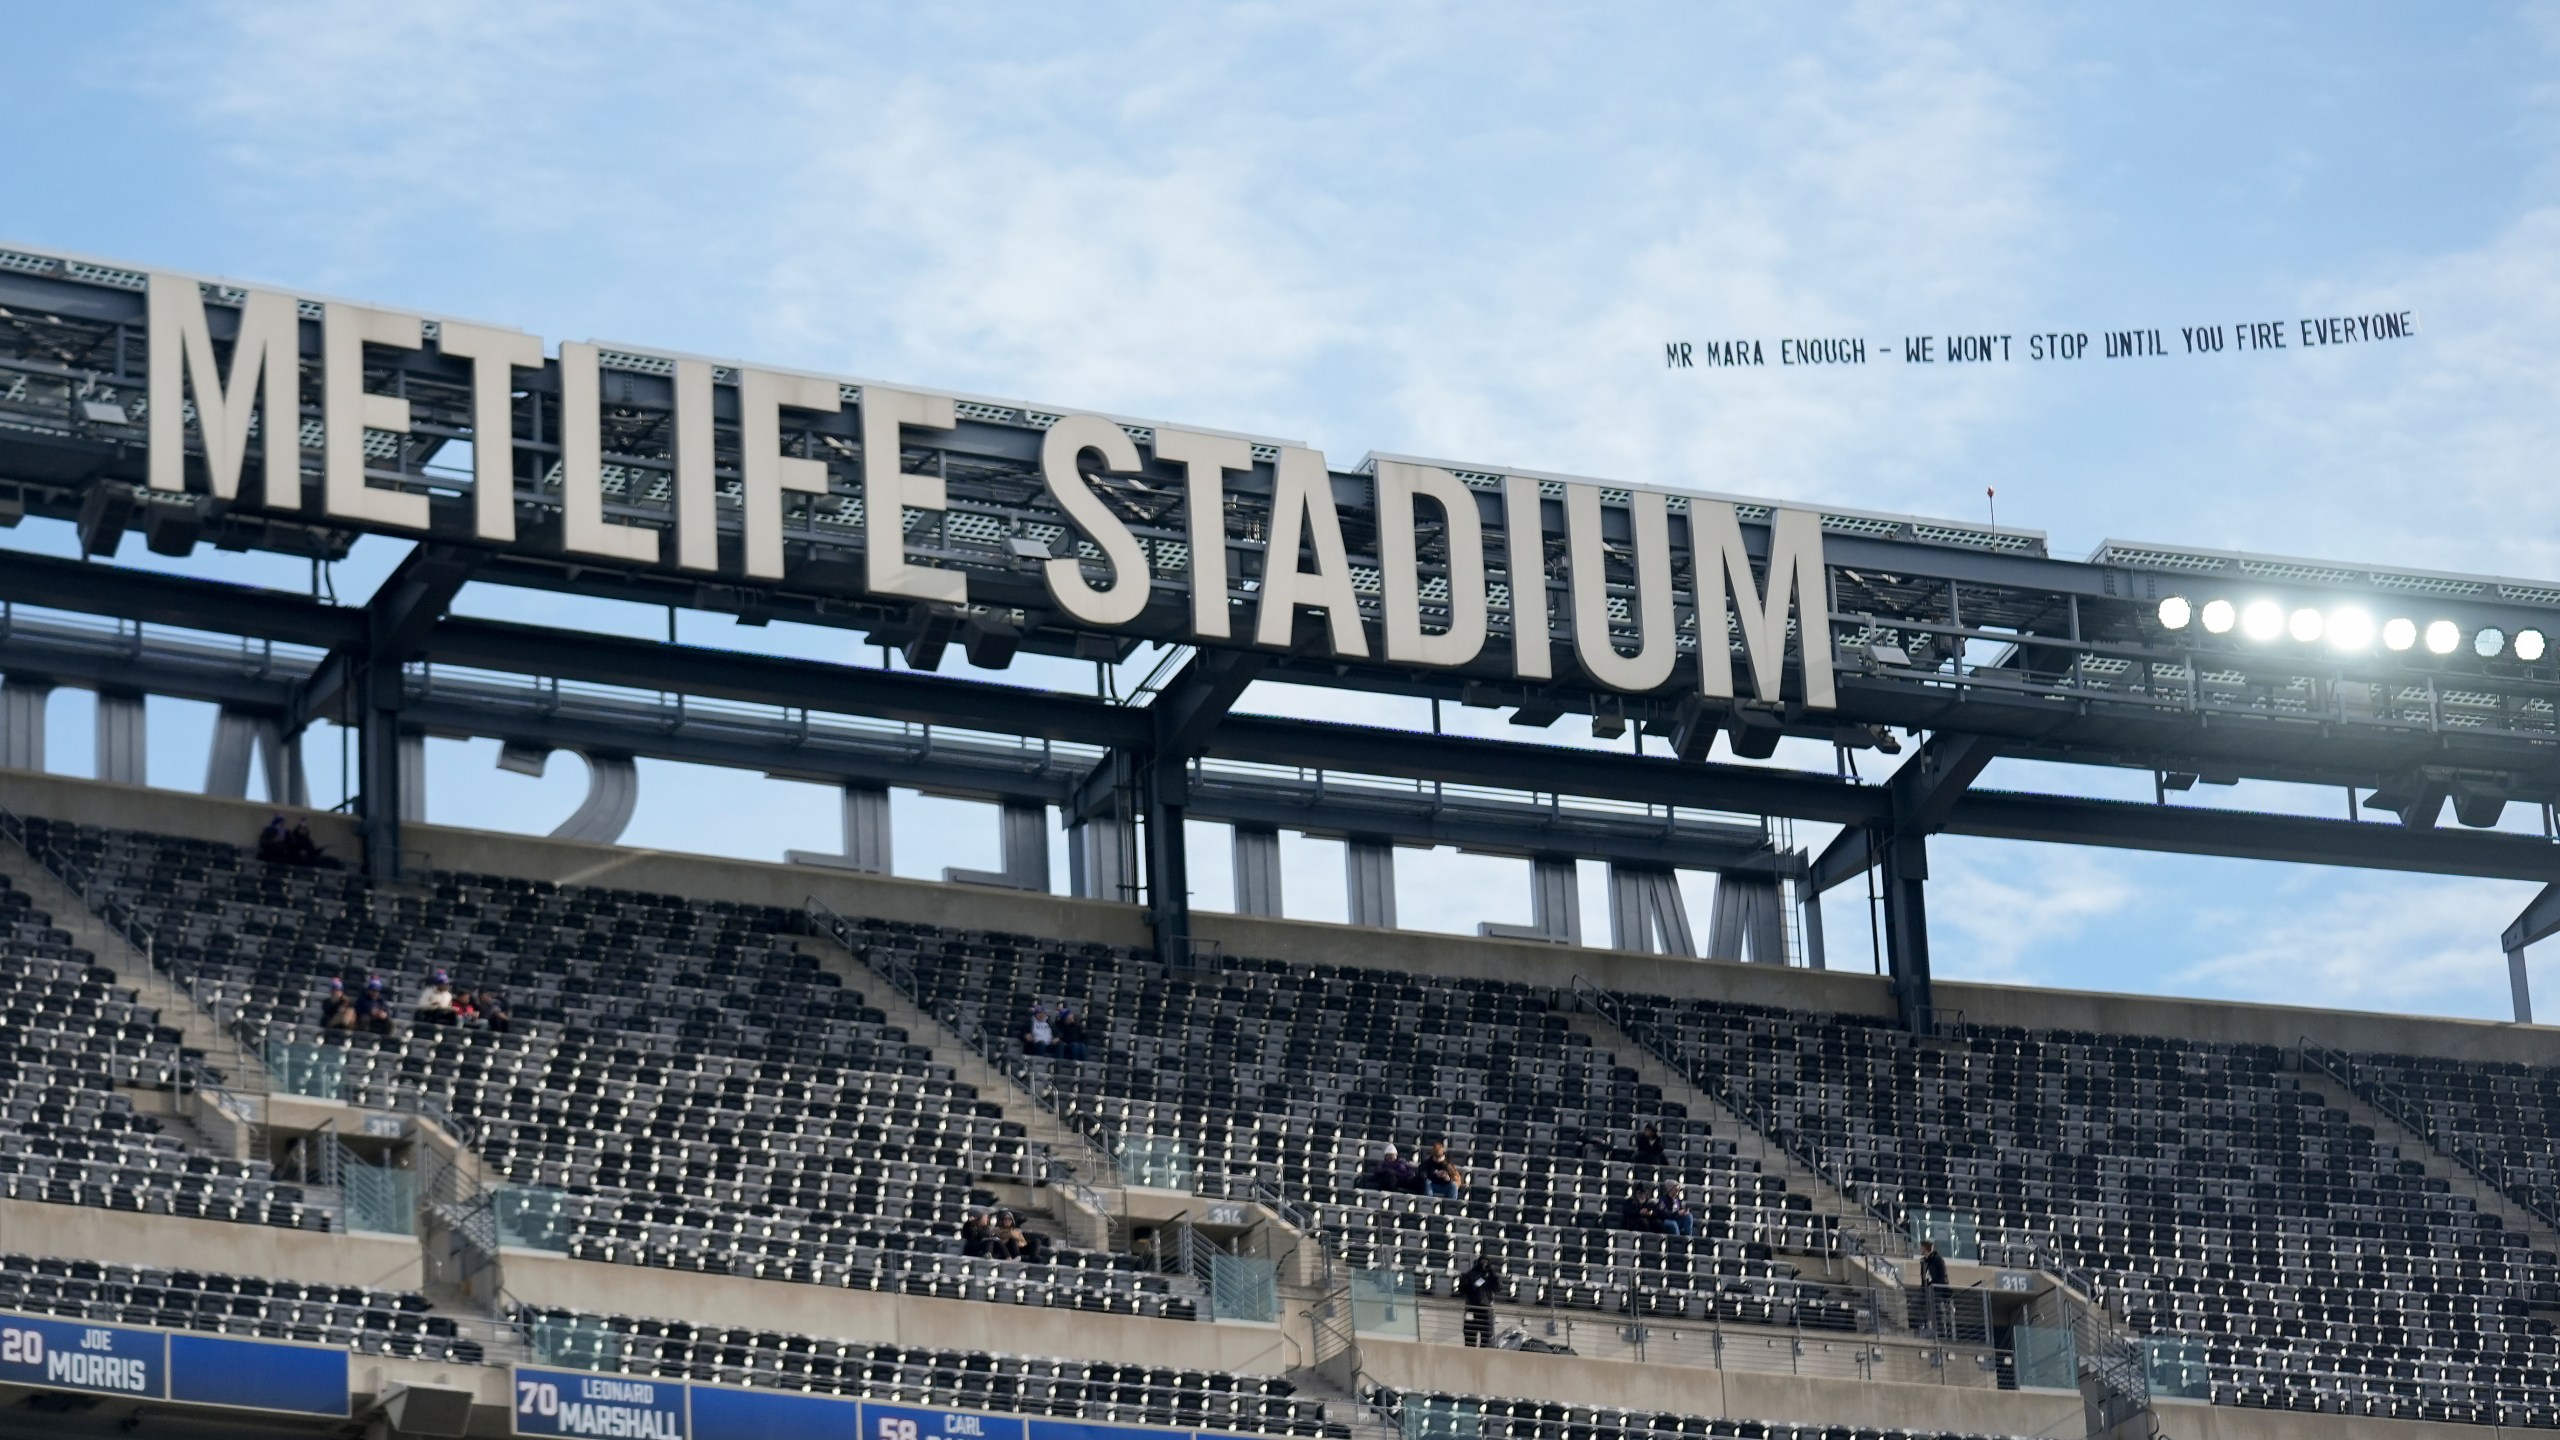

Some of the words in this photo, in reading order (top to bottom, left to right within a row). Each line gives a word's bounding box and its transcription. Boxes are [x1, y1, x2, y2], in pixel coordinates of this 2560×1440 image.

[1666, 341, 1694, 369] MR
[1707, 339, 1765, 368] MARA
[1781, 337, 1866, 365] ENOUGH
[1905, 335, 1935, 363] WE
[1947, 334, 2012, 363] WON'T
[2029, 332, 2089, 360] STOP
[2104, 329, 2169, 358] UNTIL
[2181, 325, 2224, 354] YOU
[2235, 320, 2287, 351] FIRE
[2300, 310, 2414, 348] EVERYONE
[146, 273, 967, 602] METLIFE
[1040, 414, 1836, 710] STADIUM
[2002, 1275, 2027, 1292] 315
[2, 1328, 43, 1364] 20
[80, 1328, 113, 1351] JOE
[47, 1350, 146, 1391] MORRIS
[518, 1380, 558, 1416] 70
[581, 1378, 654, 1404] LEONARD
[557, 1400, 683, 1440] MARSHALL
[878, 1417, 917, 1440] 58
[944, 1414, 984, 1436] CARL
